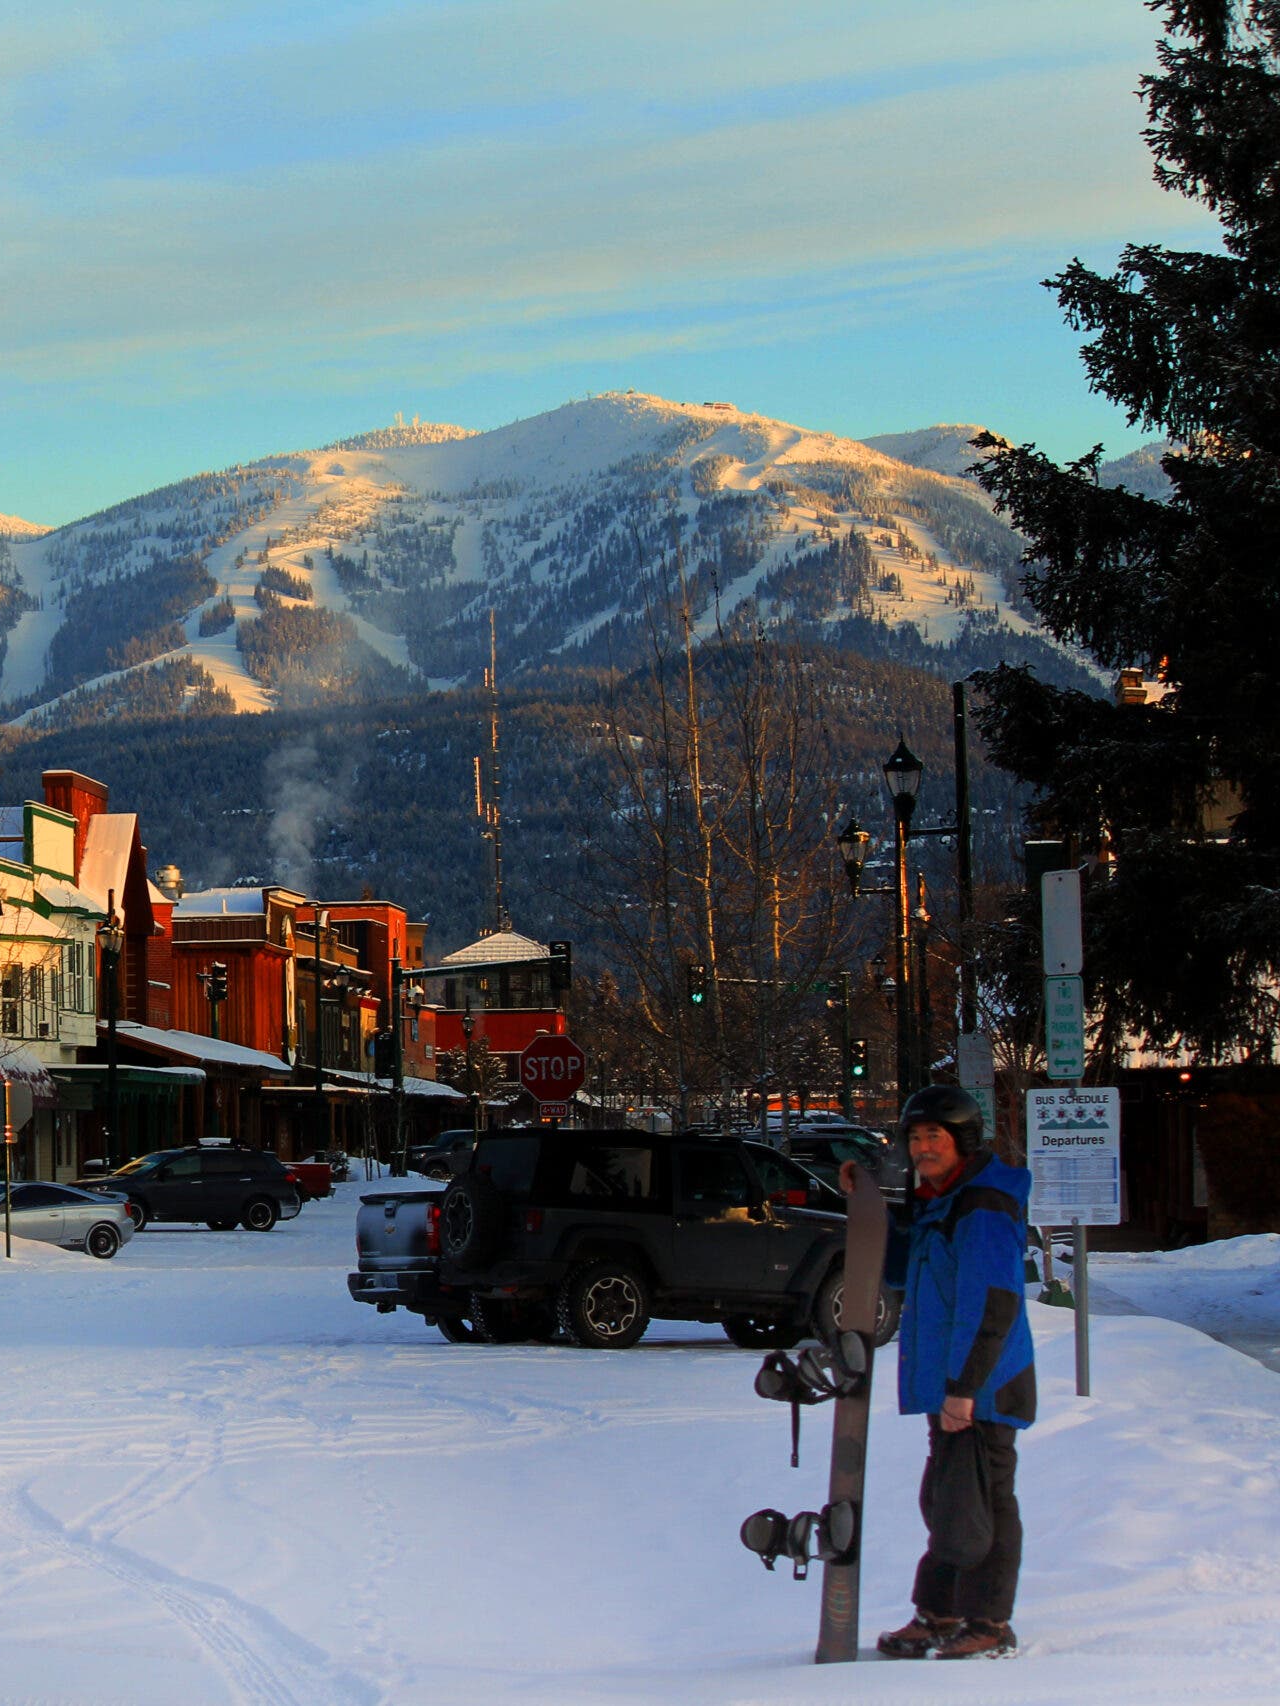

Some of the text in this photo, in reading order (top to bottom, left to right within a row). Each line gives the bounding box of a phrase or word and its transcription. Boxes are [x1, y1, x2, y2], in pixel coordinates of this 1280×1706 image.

[525, 1056, 580, 1081] STOP
[1036, 1094, 1109, 1105] BUS SCHEDULE
[542, 1106, 566, 1115] 4-WAY
[1042, 1135, 1105, 1147] Departures
